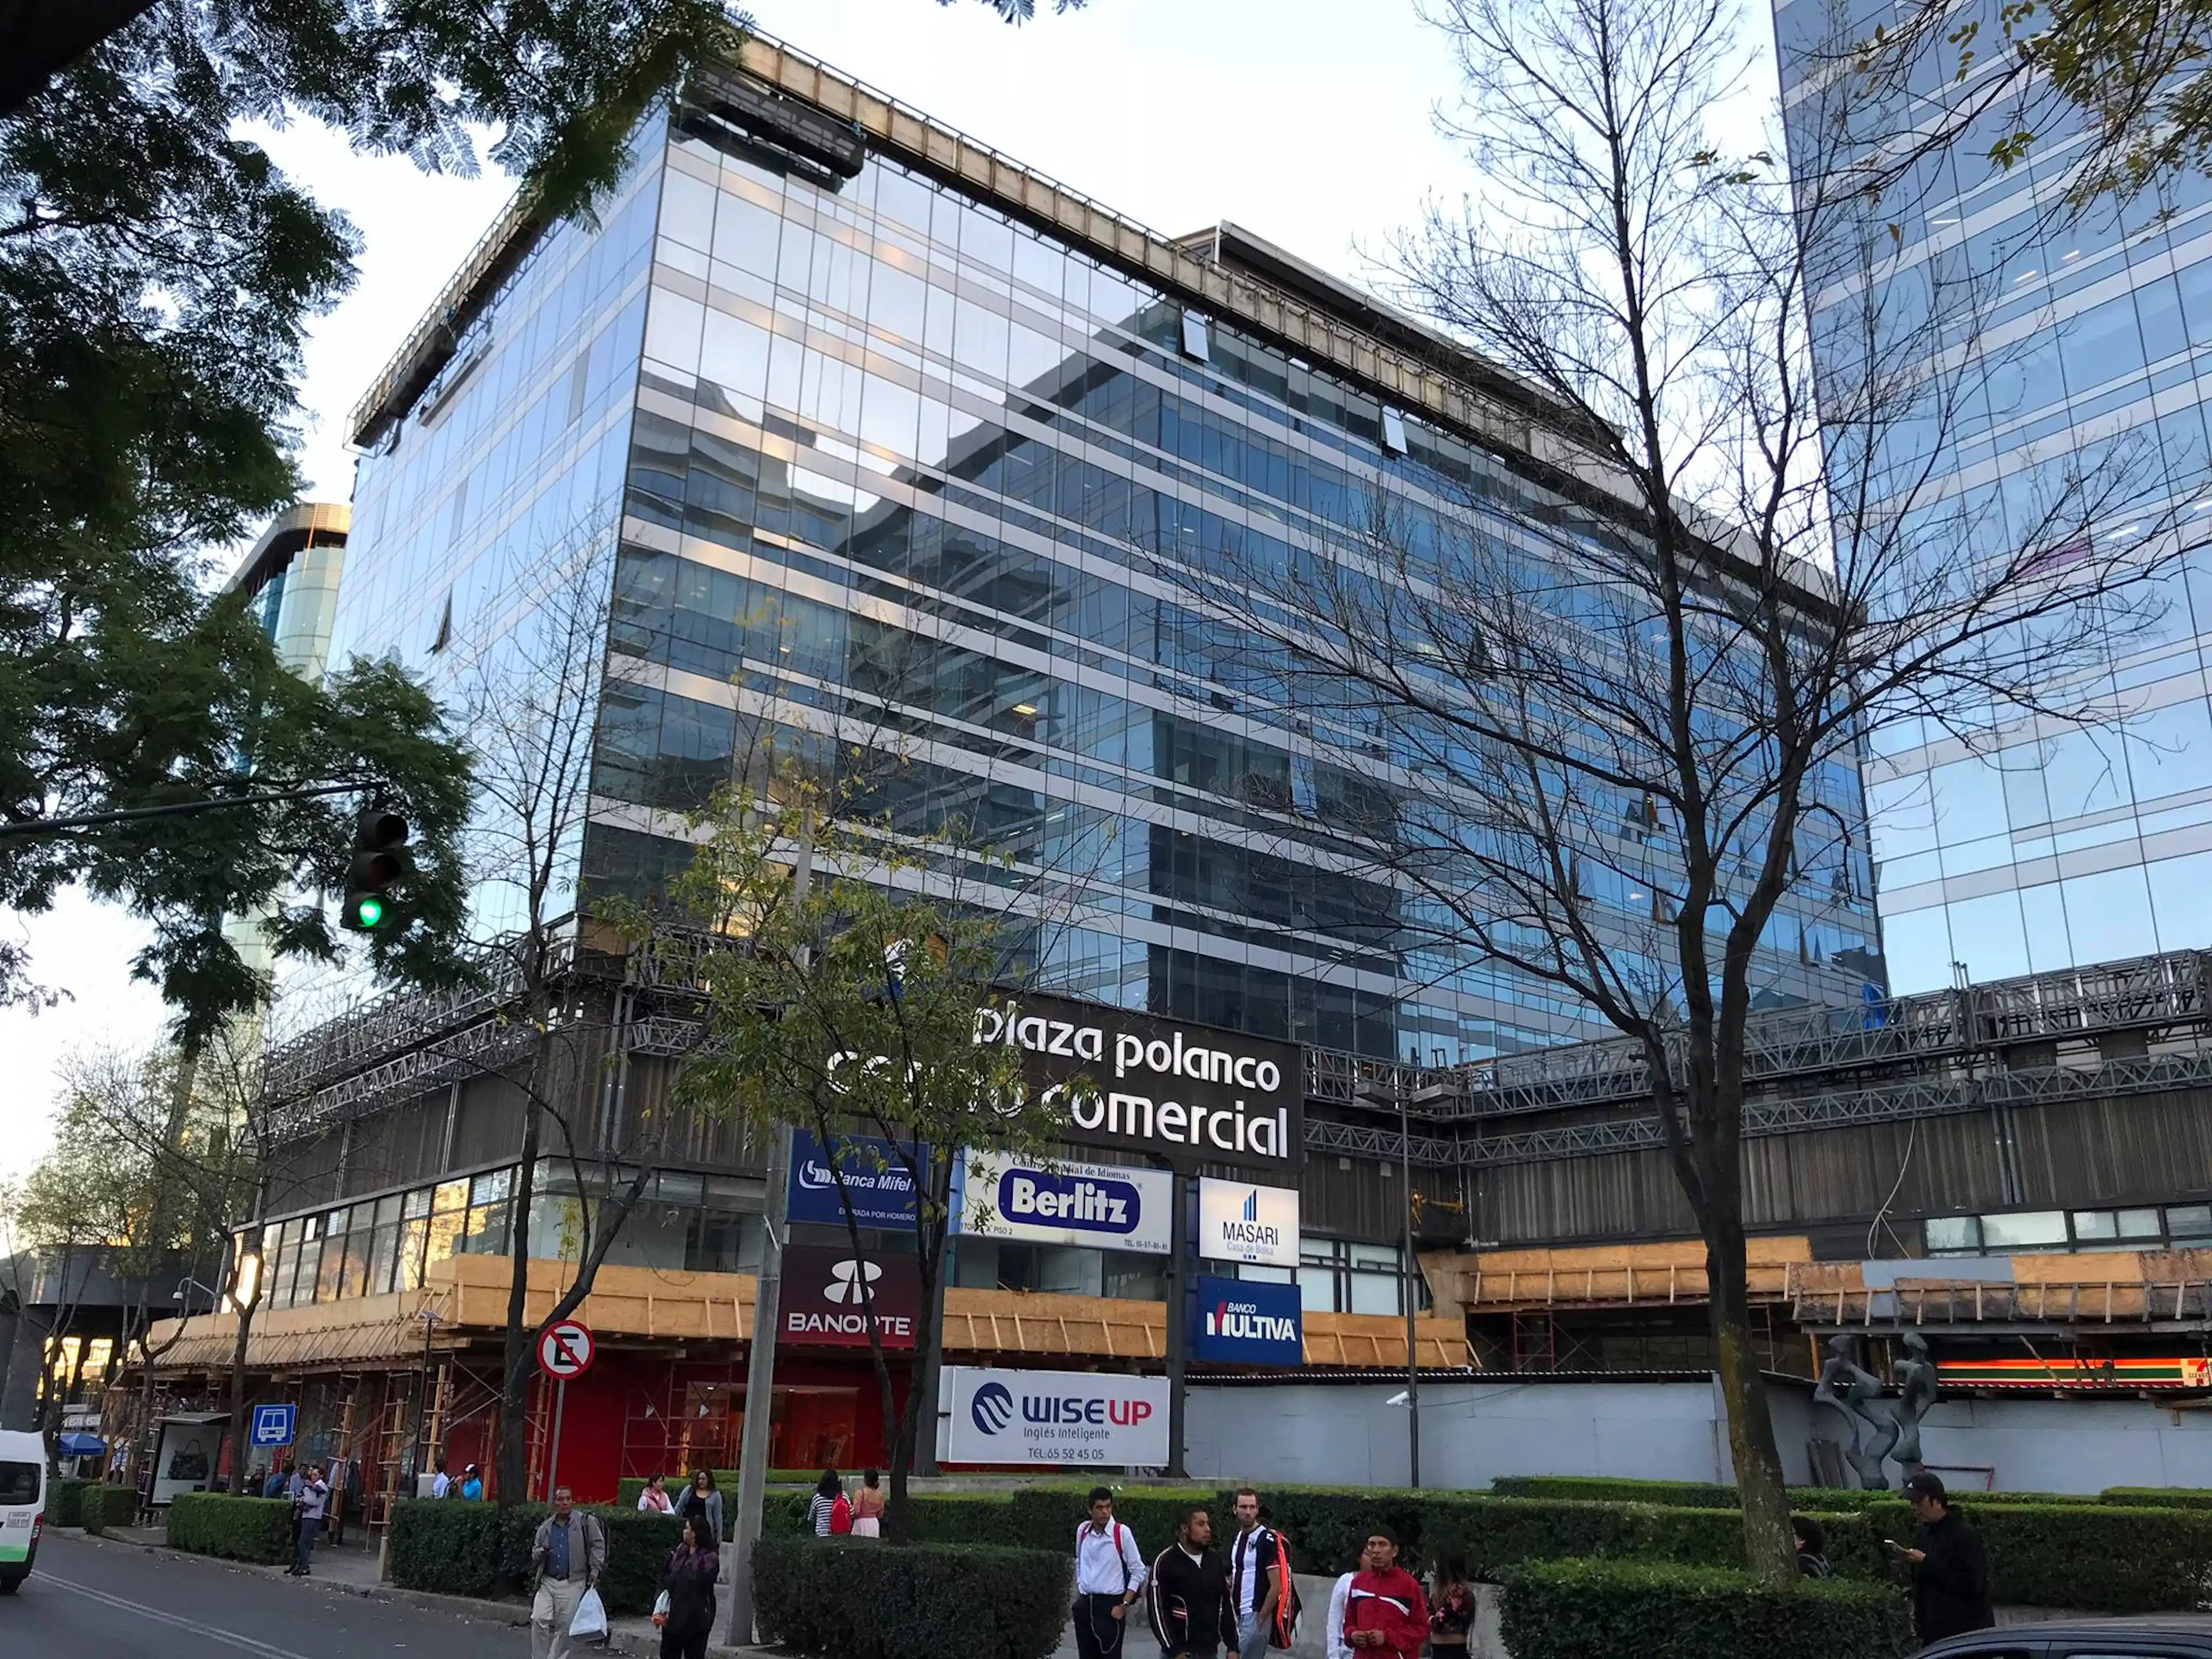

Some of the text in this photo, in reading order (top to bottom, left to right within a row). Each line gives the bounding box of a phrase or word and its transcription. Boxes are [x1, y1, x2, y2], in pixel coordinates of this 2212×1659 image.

[972, 1001, 1280, 1092] plaza polanco
[1085, 1166, 1096, 1175] de
[1097, 1167, 1131, 1180] Idiomas
[877, 1175, 912, 1191] Mifel
[1012, 1177, 1127, 1224] Berlitz
[838, 1207, 870, 1218] ERADA
[887, 1213, 916, 1222] HOMERO
[1223, 1221, 1278, 1245] MASARI
[1227, 1241, 1274, 1256] Casa de Bolsa
[1228, 1301, 1257, 1315] BANCO
[1207, 1302, 1297, 1342] MULTIVA
[1024, 1426, 1110, 1443] Inglés Inteligente
[1062, 1448, 1075, 1460] 52
[1078, 1449, 1089, 1460] 45
[1092, 1449, 1104, 1460] 05
